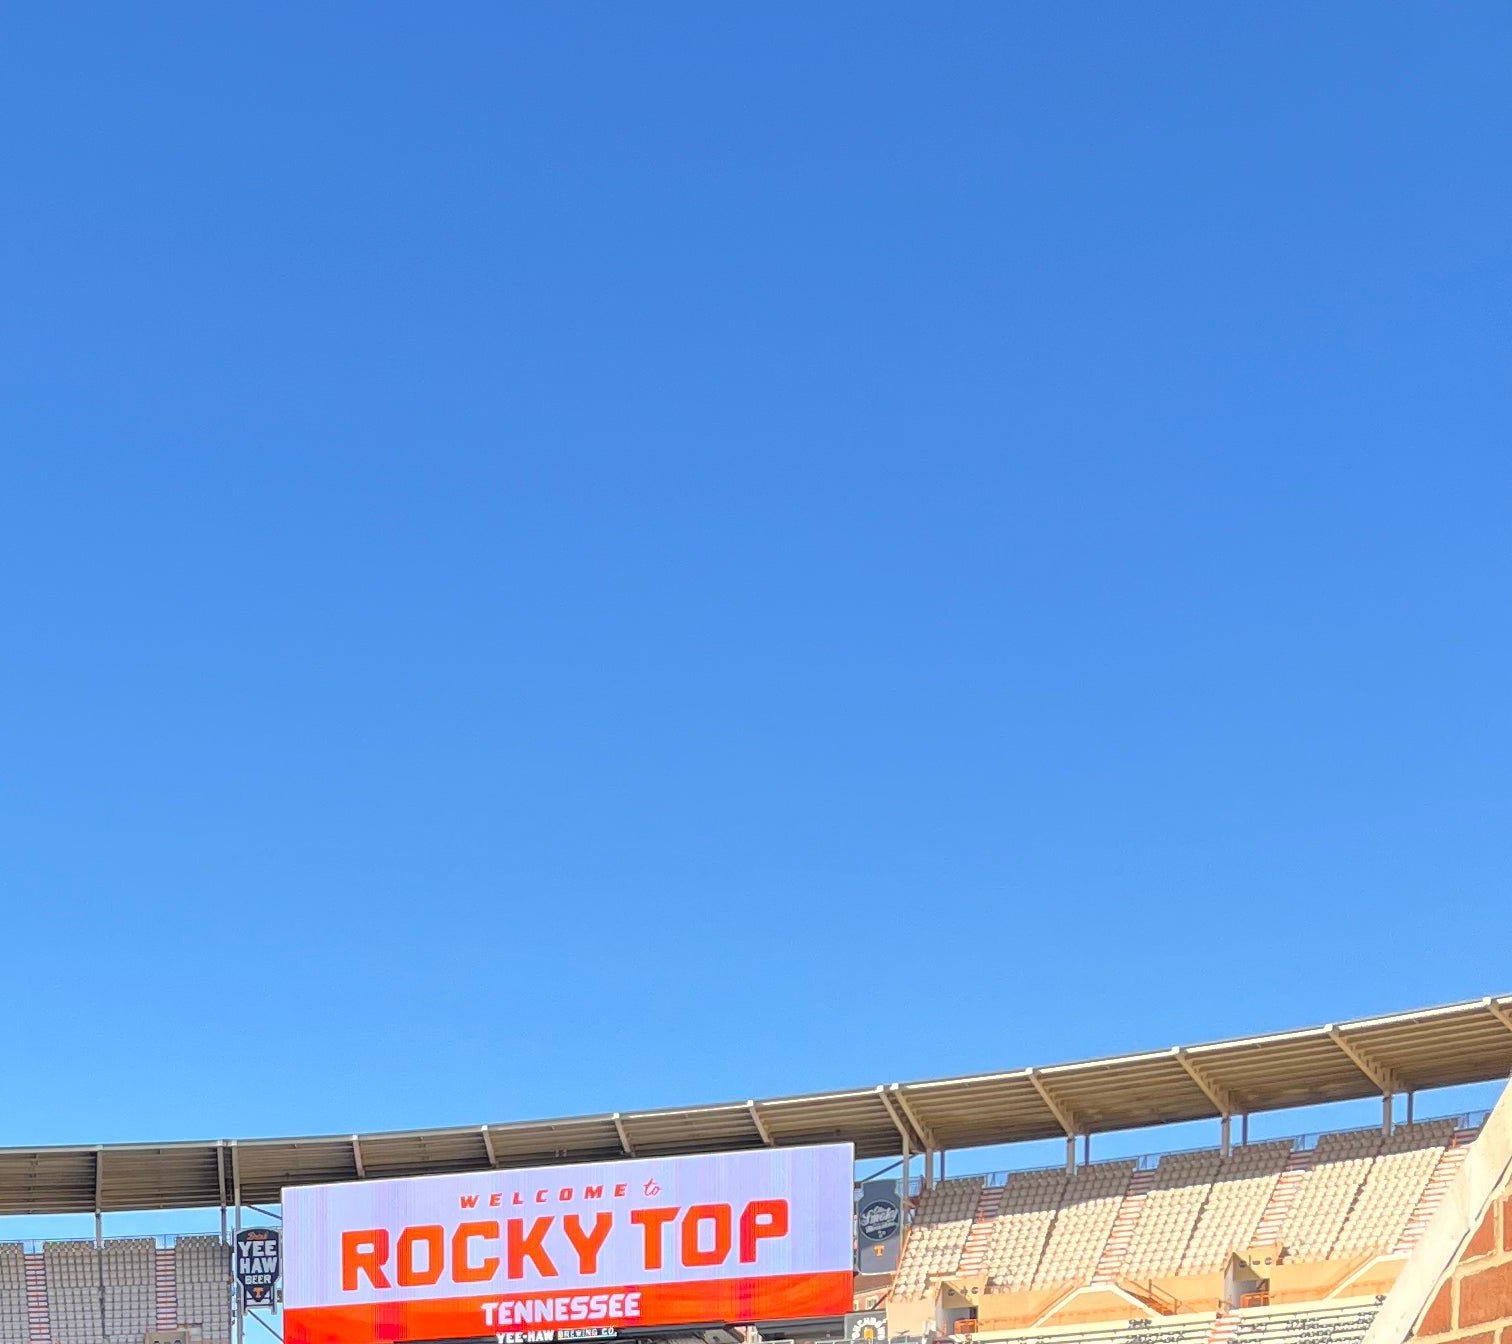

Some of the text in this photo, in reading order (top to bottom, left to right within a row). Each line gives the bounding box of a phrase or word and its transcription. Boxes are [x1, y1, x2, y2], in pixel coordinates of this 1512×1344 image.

[459, 1178, 661, 1208] WELCOME to
[238, 1240, 277, 1257] YEE
[340, 1198, 790, 1292] ROCKY TOP
[240, 1257, 278, 1274] HAW
[244, 1275, 271, 1285] BEER
[481, 1292, 641, 1326] TENNESSEE
